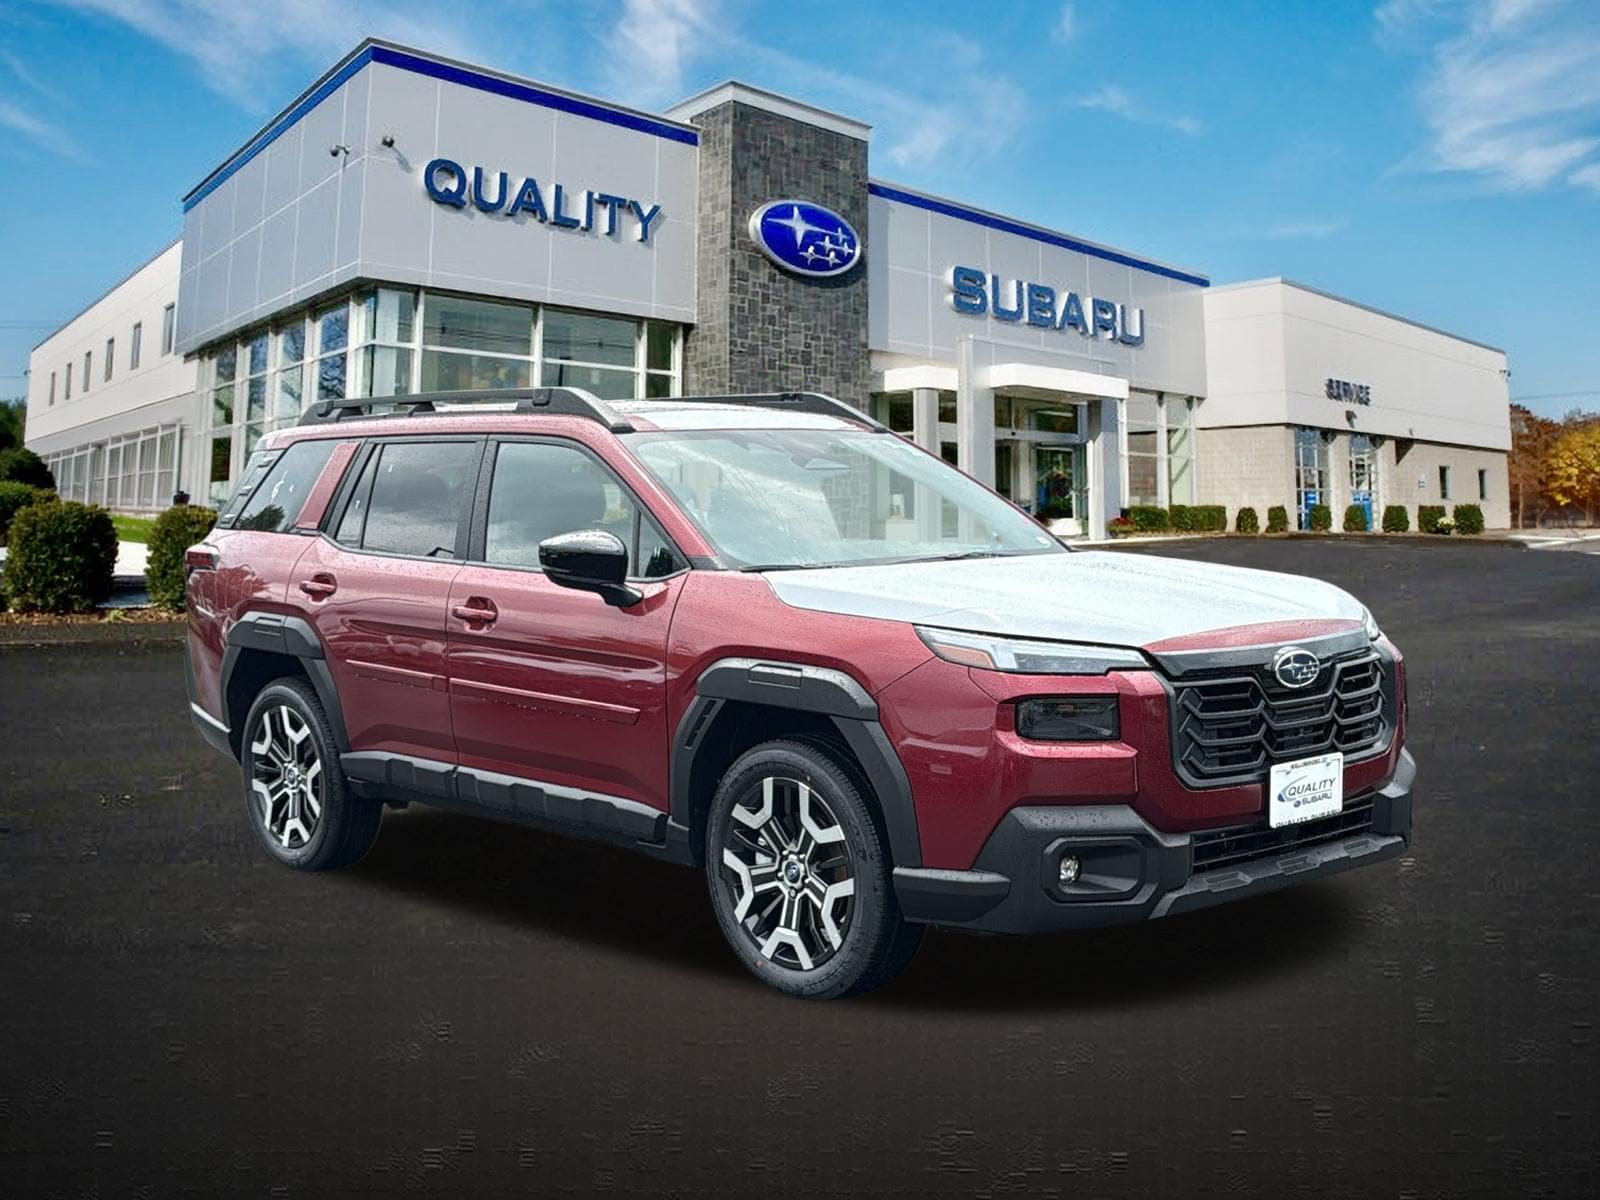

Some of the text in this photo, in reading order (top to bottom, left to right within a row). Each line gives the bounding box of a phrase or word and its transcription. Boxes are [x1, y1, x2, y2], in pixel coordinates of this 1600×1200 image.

[424, 158, 662, 243] QUALITY
[947, 265, 1145, 346] SUBARU
[1325, 378, 1371, 406] SERVICE
[1288, 777, 1336, 797] QUALITY
[1301, 792, 1333, 806] SUBARU
